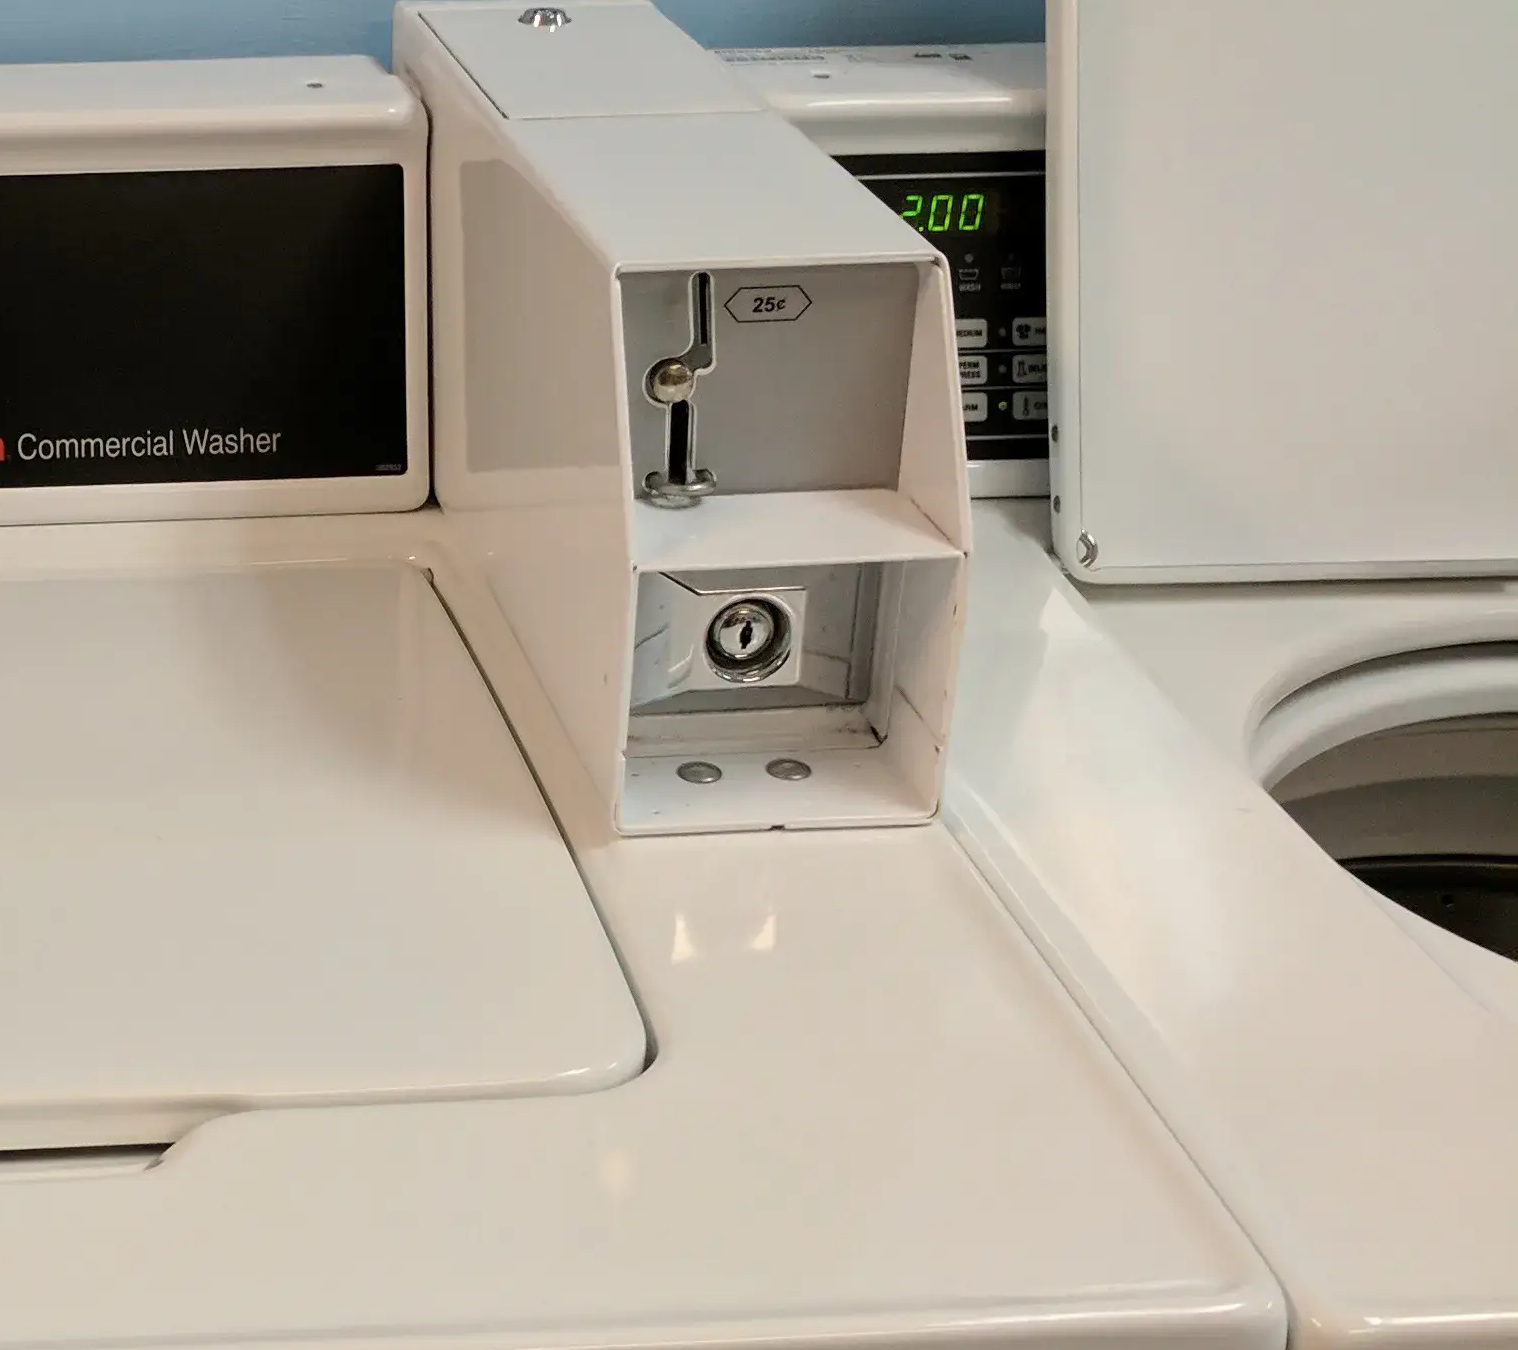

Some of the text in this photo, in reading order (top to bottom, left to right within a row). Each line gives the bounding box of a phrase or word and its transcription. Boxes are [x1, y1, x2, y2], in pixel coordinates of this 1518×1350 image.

[902, 193, 985, 232] 2.00
[752, 296, 786, 313] 25¢
[17, 430, 174, 461] Commercial
[182, 427, 282, 456] Washer
